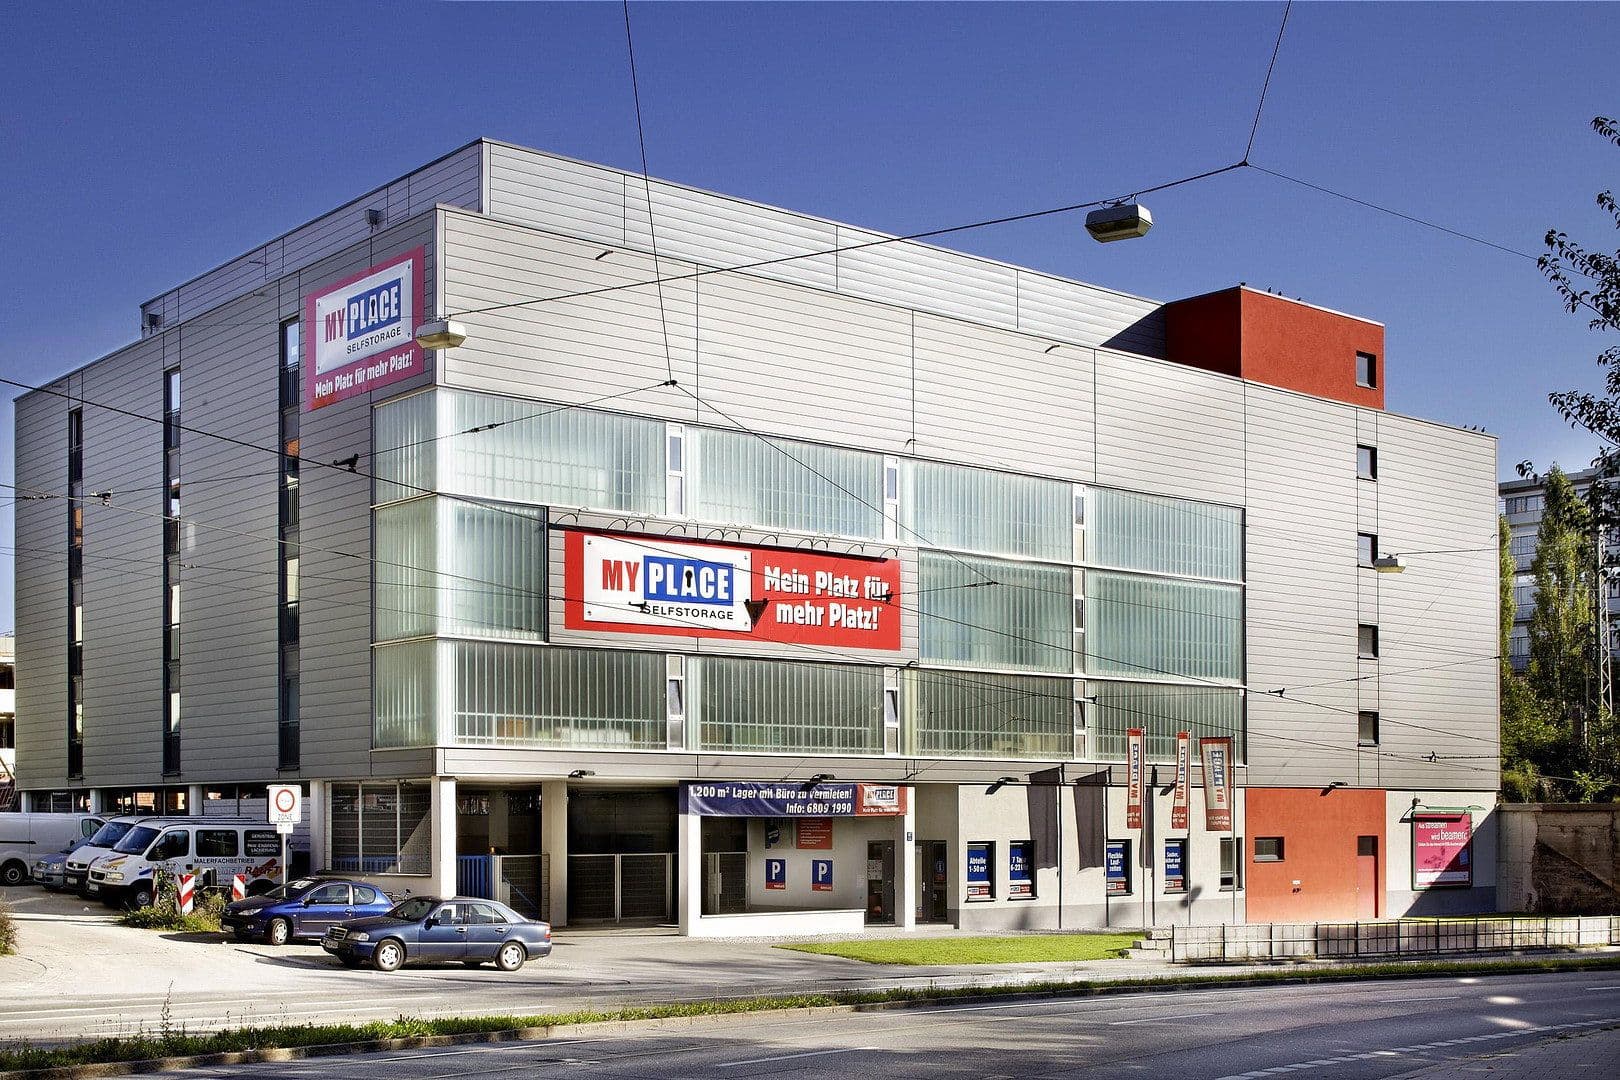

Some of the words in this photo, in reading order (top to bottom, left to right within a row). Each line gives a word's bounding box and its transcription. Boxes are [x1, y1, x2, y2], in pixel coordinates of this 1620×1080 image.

[346, 327, 402, 355] SELFSTORAGE
[315, 379, 334, 399] Mein
[335, 372, 354, 392] Platz
[354, 367, 366, 385] für
[367, 359, 389, 380] mehr
[390, 350, 413, 372] Platz!
[764, 565, 810, 595] Mein
[815, 570, 859, 599] Platz
[863, 575, 890, 601] für
[643, 604, 734, 620] SELFSTORAGE
[776, 600, 825, 626] mehr
[829, 602, 879, 631] Platz!
[690, 786, 716, 798] 1.200
[718, 786, 730, 798] m²
[732, 787, 758, 800] Lager
[759, 788, 774, 800] mit
[776, 788, 796, 800] Büro
[797, 791, 807, 800] zu
[810, 788, 853, 801] vermieten!
[786, 803, 805, 814] Info:
[806, 803, 829, 814] 6809
[832, 802, 852, 814] 1990
[771, 861, 781, 880] P
[818, 862, 828, 882] P
